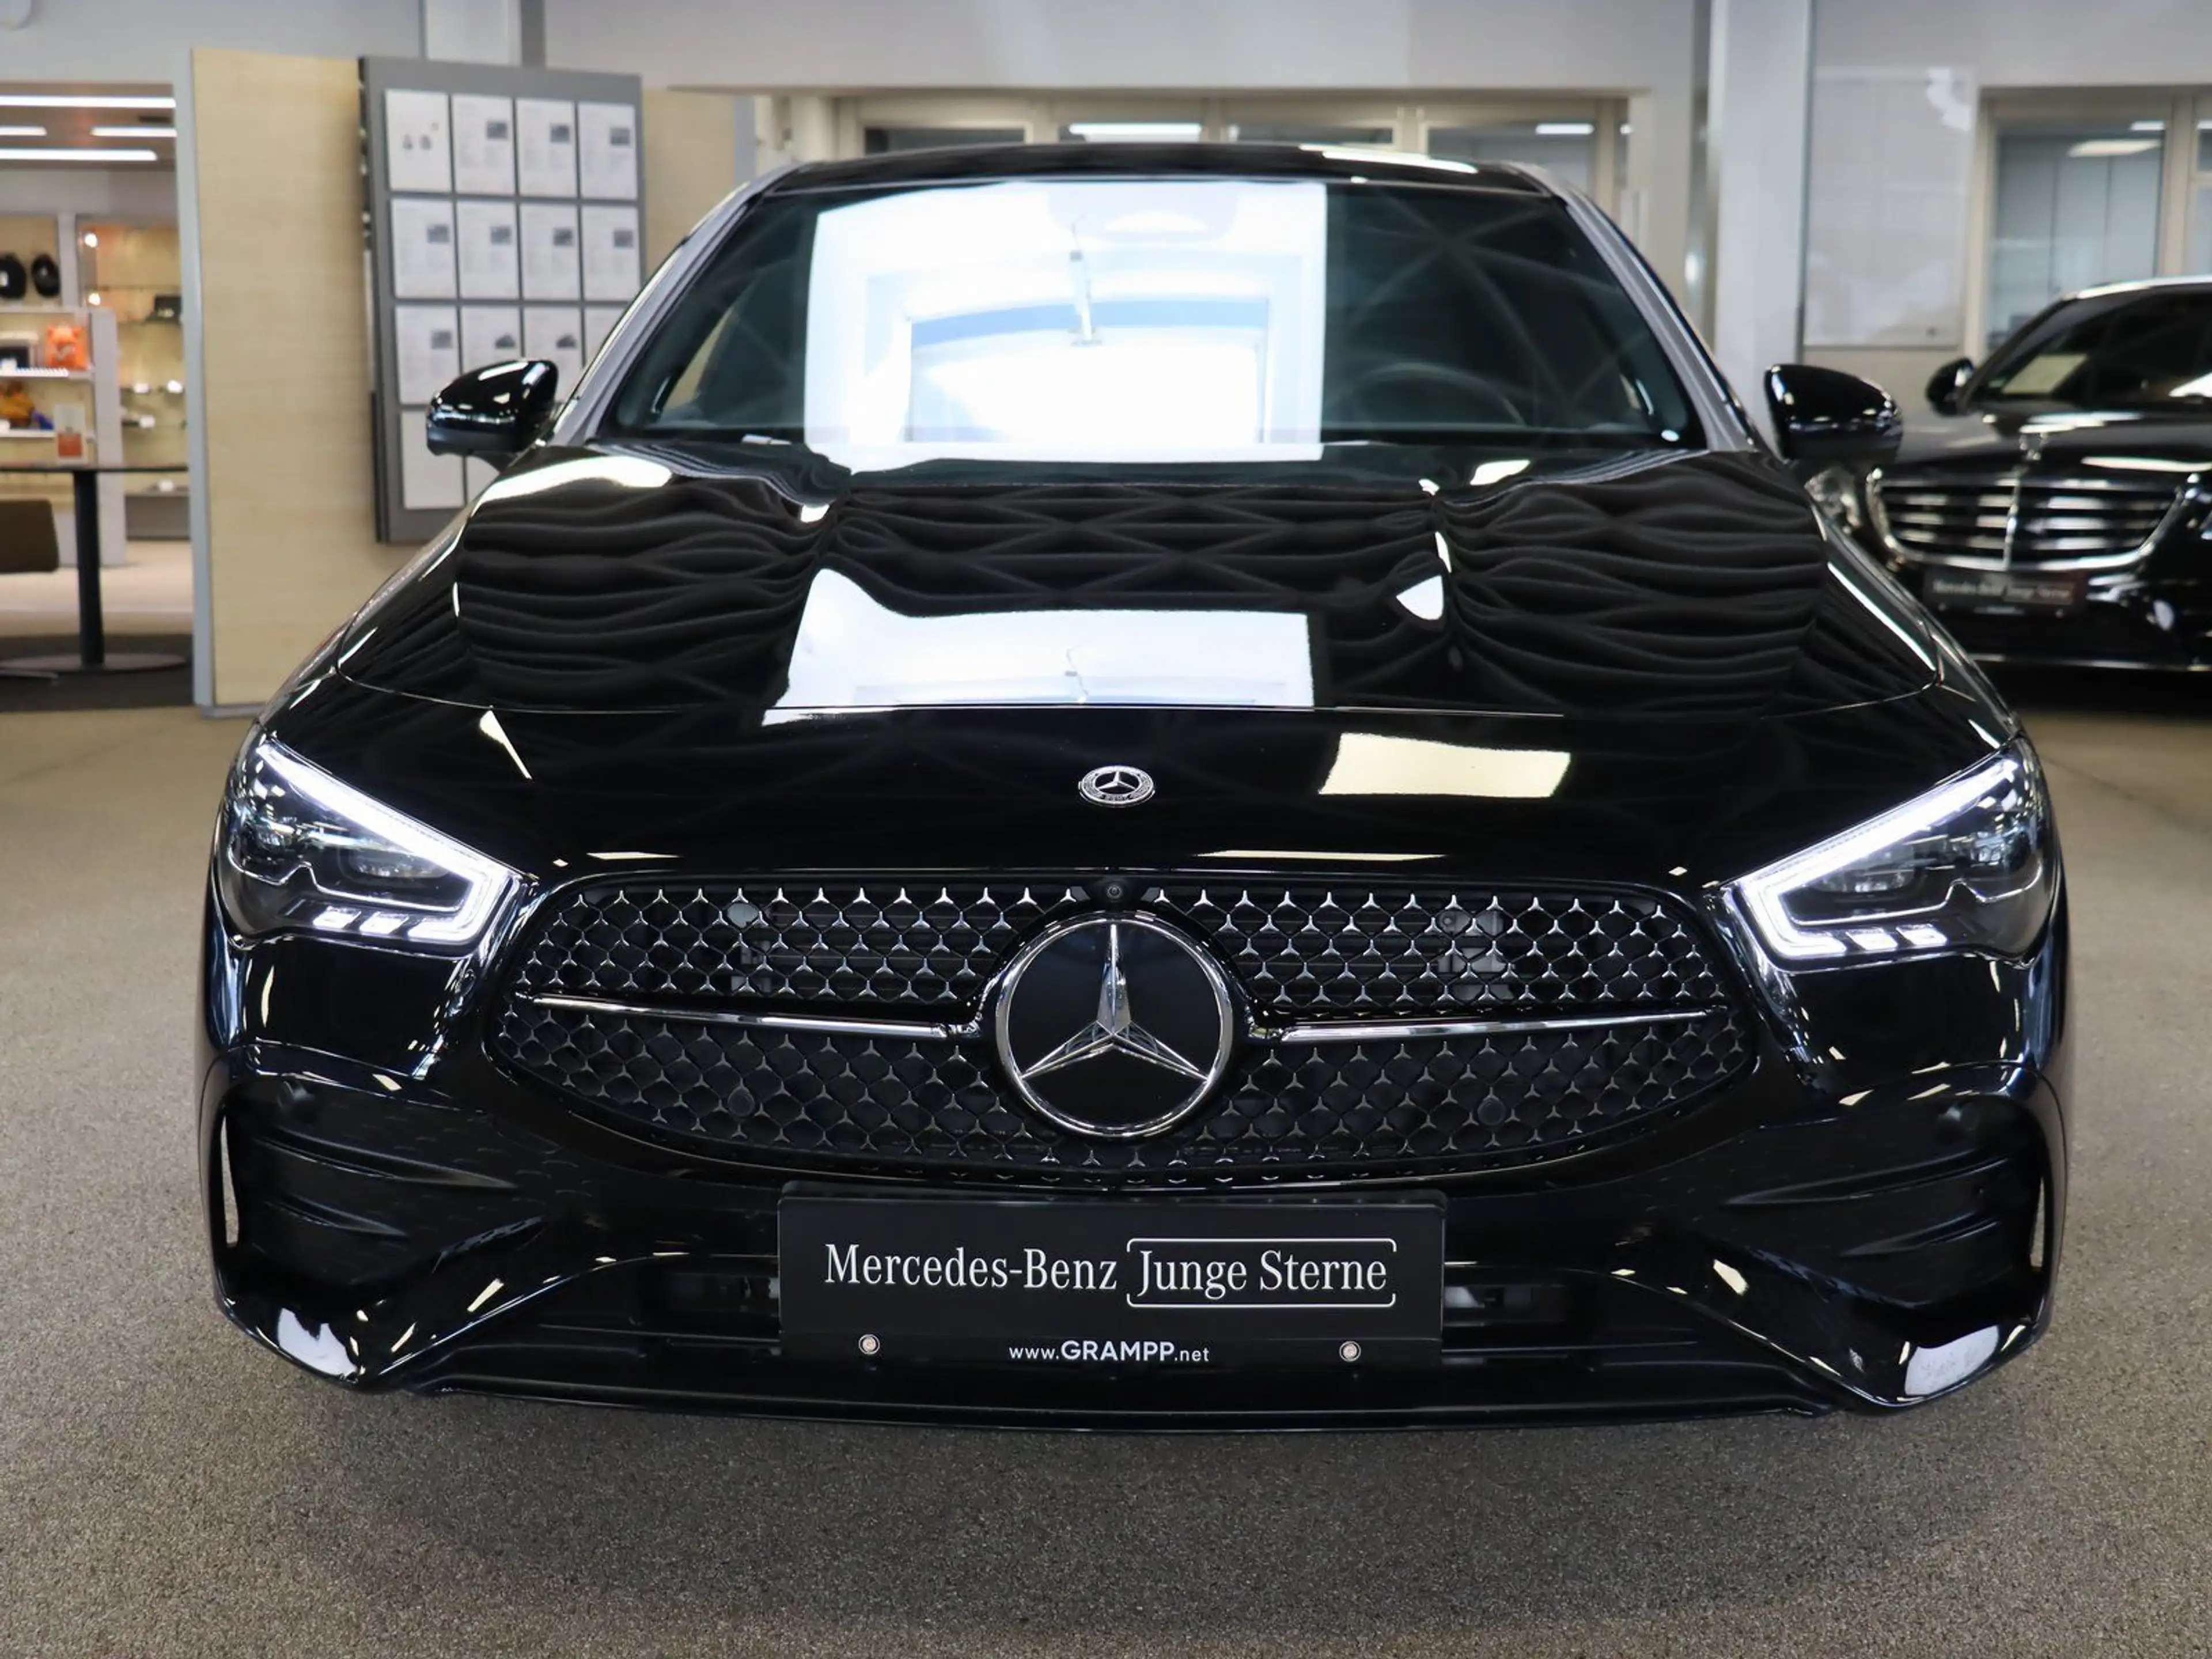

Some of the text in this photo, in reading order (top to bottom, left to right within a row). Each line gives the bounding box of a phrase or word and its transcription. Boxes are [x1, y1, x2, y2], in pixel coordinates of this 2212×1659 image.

[824, 1244, 1387, 1300] Mercedes-Benz Junge Sterne
[1009, 1340, 1209, 1362] www.GRAMPP.net
